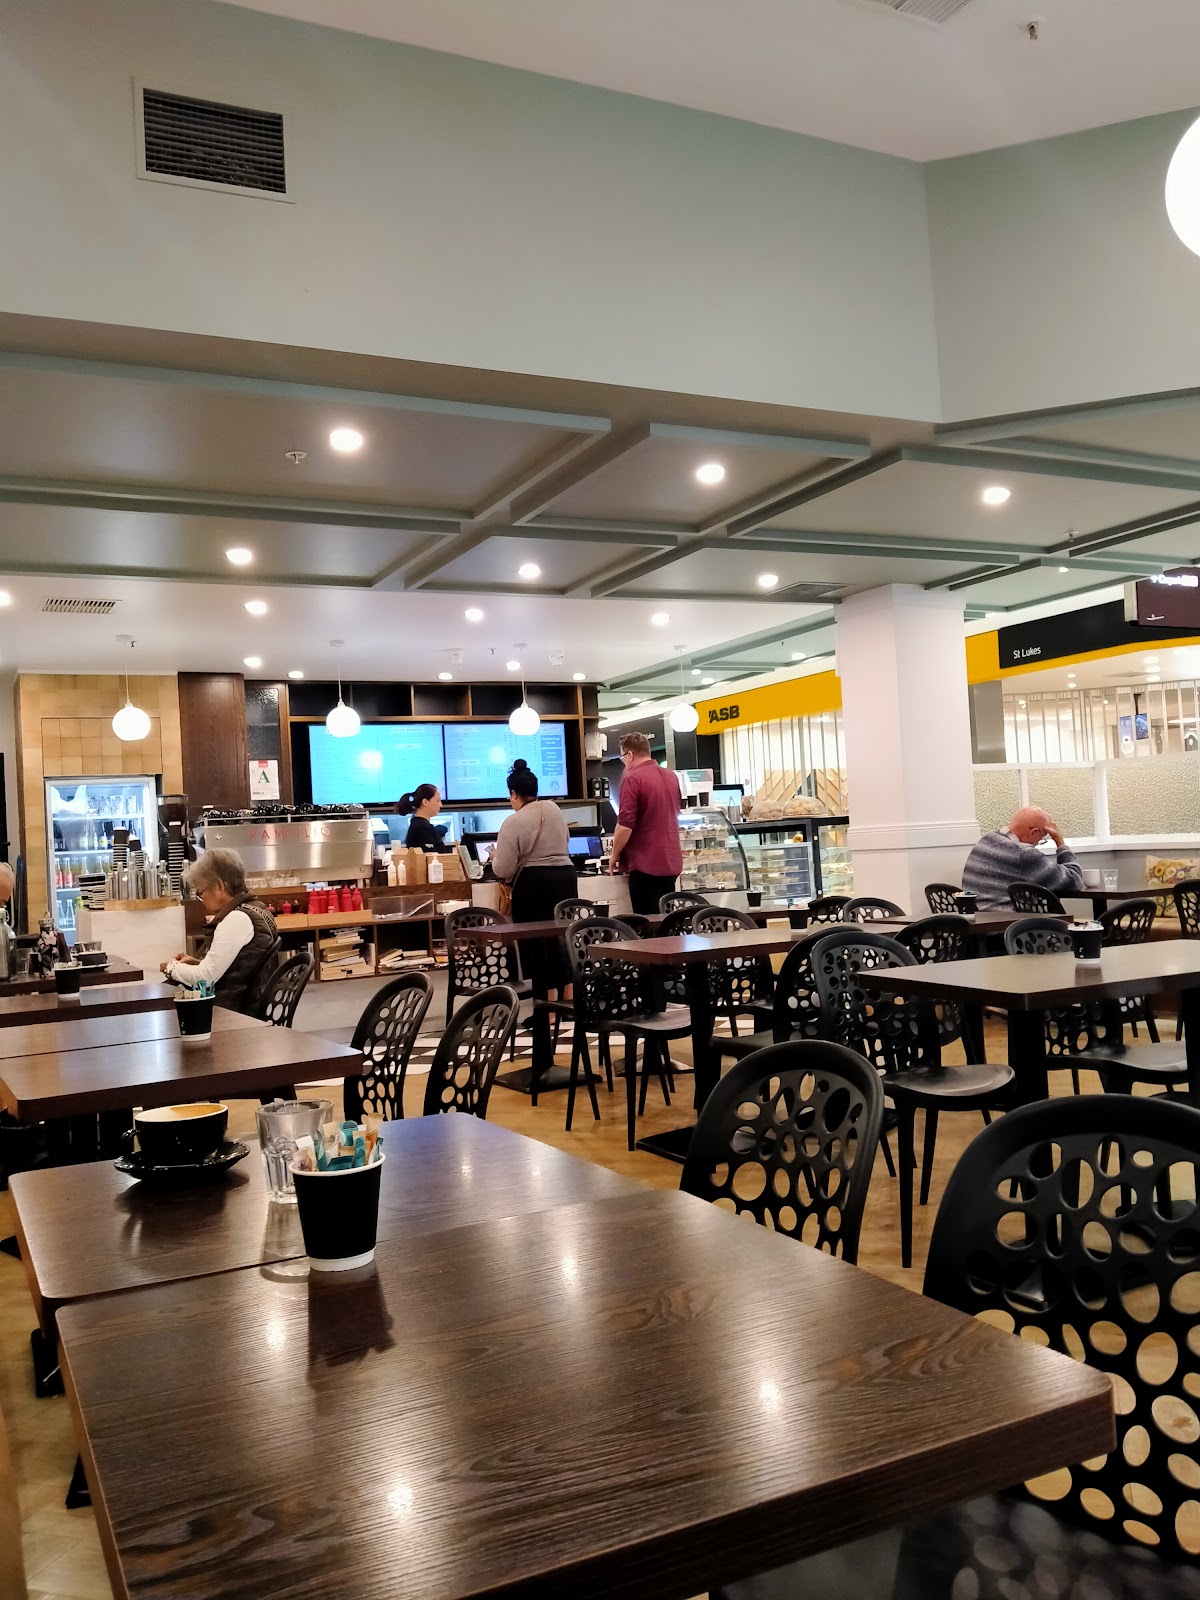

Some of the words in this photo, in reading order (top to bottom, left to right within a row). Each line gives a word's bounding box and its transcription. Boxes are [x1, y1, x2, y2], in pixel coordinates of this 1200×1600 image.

[1013, 649, 1021, 659] St
[1021, 646, 1042, 658] Lukes
[708, 705, 740, 723] ASB
[258, 769, 270, 783] A
[249, 825, 331, 840] RANCILIO
